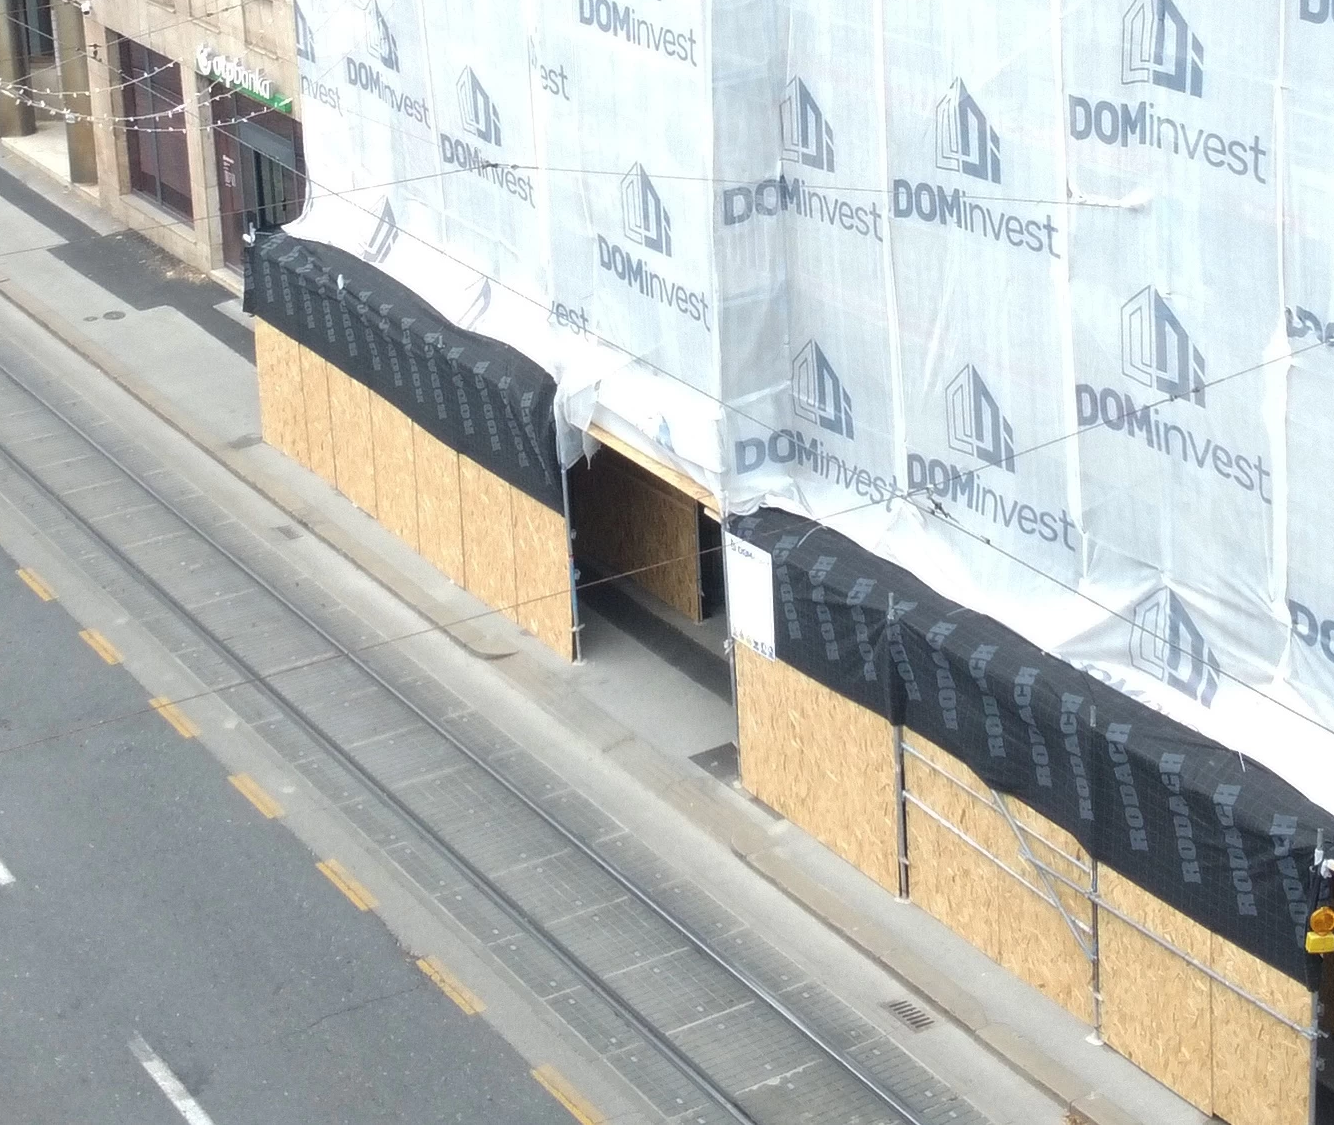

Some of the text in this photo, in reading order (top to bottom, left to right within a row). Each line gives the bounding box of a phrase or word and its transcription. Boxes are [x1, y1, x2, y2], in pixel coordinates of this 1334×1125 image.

[347, 56, 432, 130] DOMinvest
[1069, 94, 1267, 184] DOMinvest
[440, 132, 536, 210] DOMinvest
[723, 174, 884, 243] DOMinvest
[892, 178, 1062, 260] DOMinvest
[597, 232, 712, 333] DOMinvest
[735, 438, 899, 513] DOMinvest
[1077, 383, 1273, 507] DOMinvest
[907, 451, 1077, 553] DOMinvest
[1014, 666, 1053, 788] RODACH
[1060, 693, 1095, 821] RODACH
[1106, 722, 1149, 851] RODACH
[1160, 752, 1202, 884] RODACH
[1213, 783, 1258, 916] RODACH
